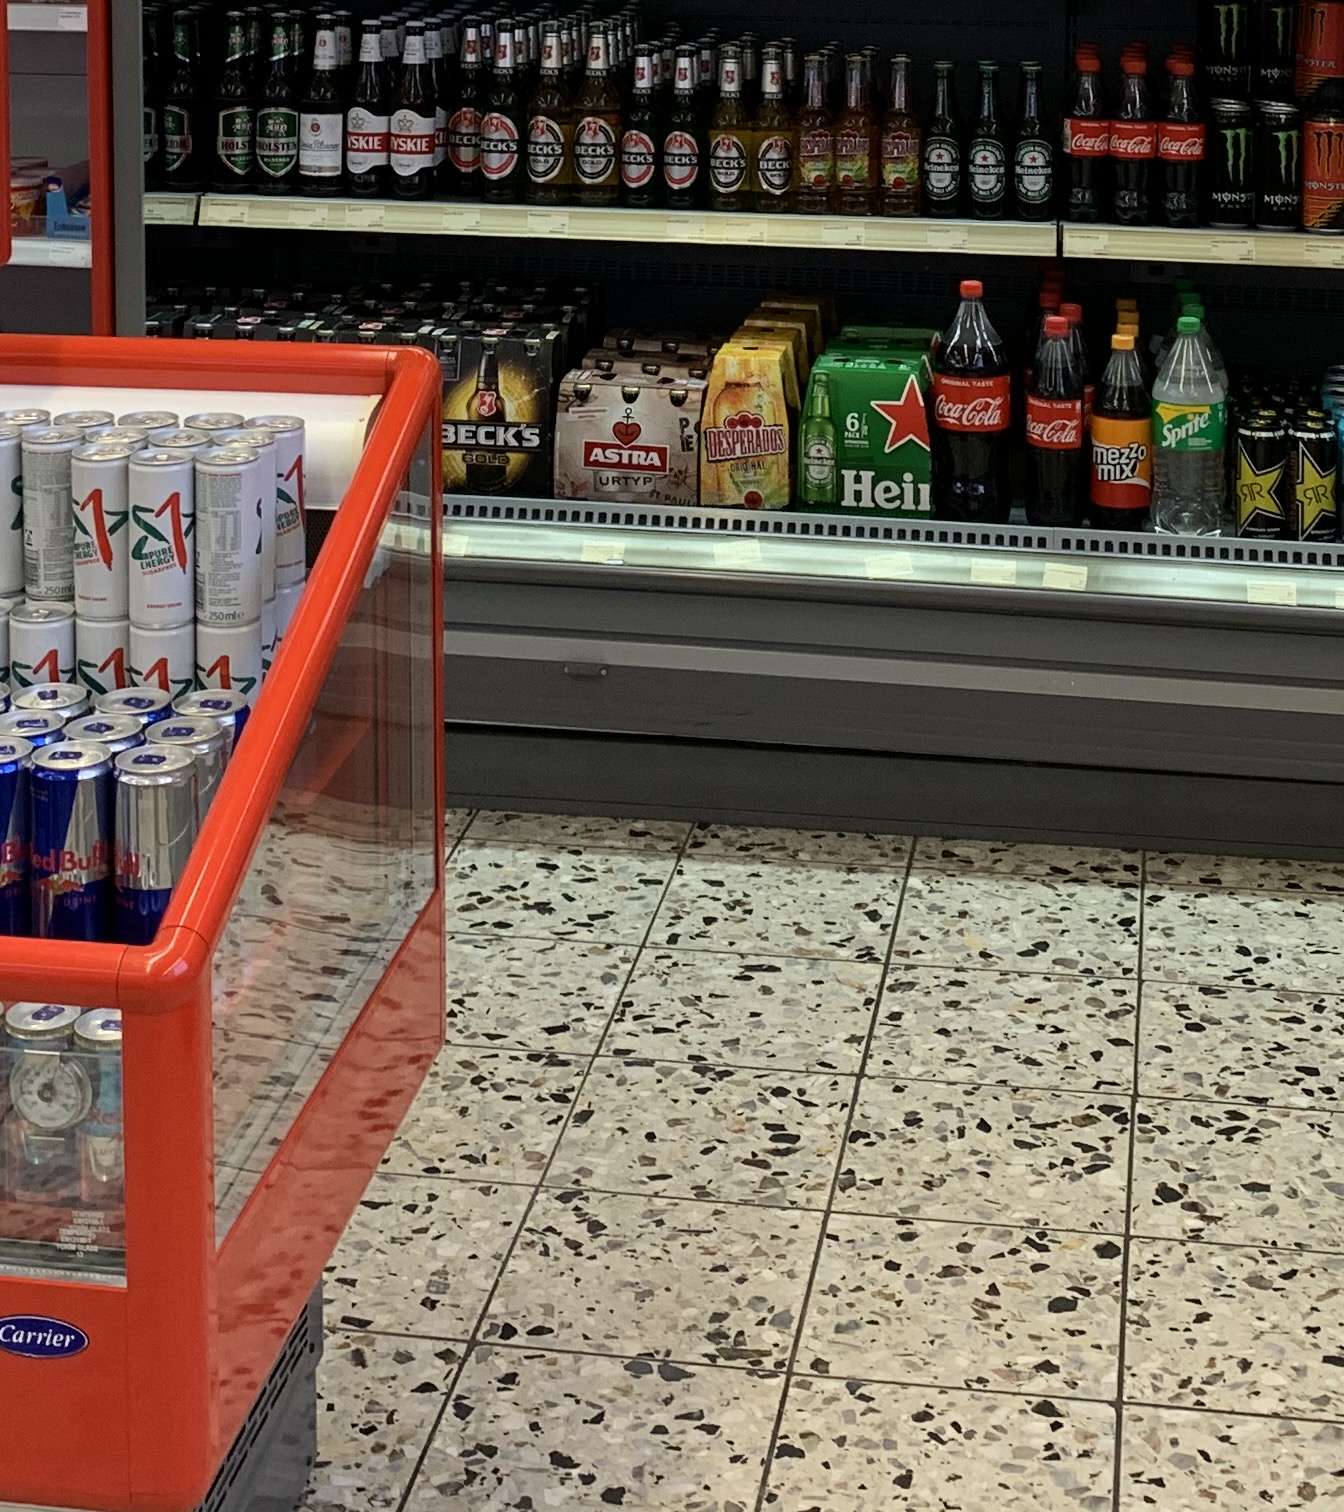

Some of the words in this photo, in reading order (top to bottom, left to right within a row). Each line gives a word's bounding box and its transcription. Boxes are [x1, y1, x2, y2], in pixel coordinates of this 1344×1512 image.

[575, 143, 615, 155] BECK'S
[1160, 136, 1203, 157] Coca-Cola
[710, 157, 746, 169] BECK'S
[924, 162, 960, 173] Heineken
[968, 164, 1005, 174] Heineken
[1015, 165, 1052, 176] Heineken
[934, 397, 1002, 426] Coca-Cola
[845, 412, 859, 431] 6
[1161, 412, 1210, 448] Sprite
[442, 423, 541, 447] BECK'S
[708, 427, 786, 462] DESPERADOS
[461, 452, 510, 465] GOLD
[587, 449, 662, 468] ASTRA
[1092, 441, 1147, 468] mezzo
[599, 475, 653, 487] URTYP
[1097, 463, 1135, 483] mix
[148, 545, 173, 558] PURE
[140, 554, 175, 570] ENERGY
